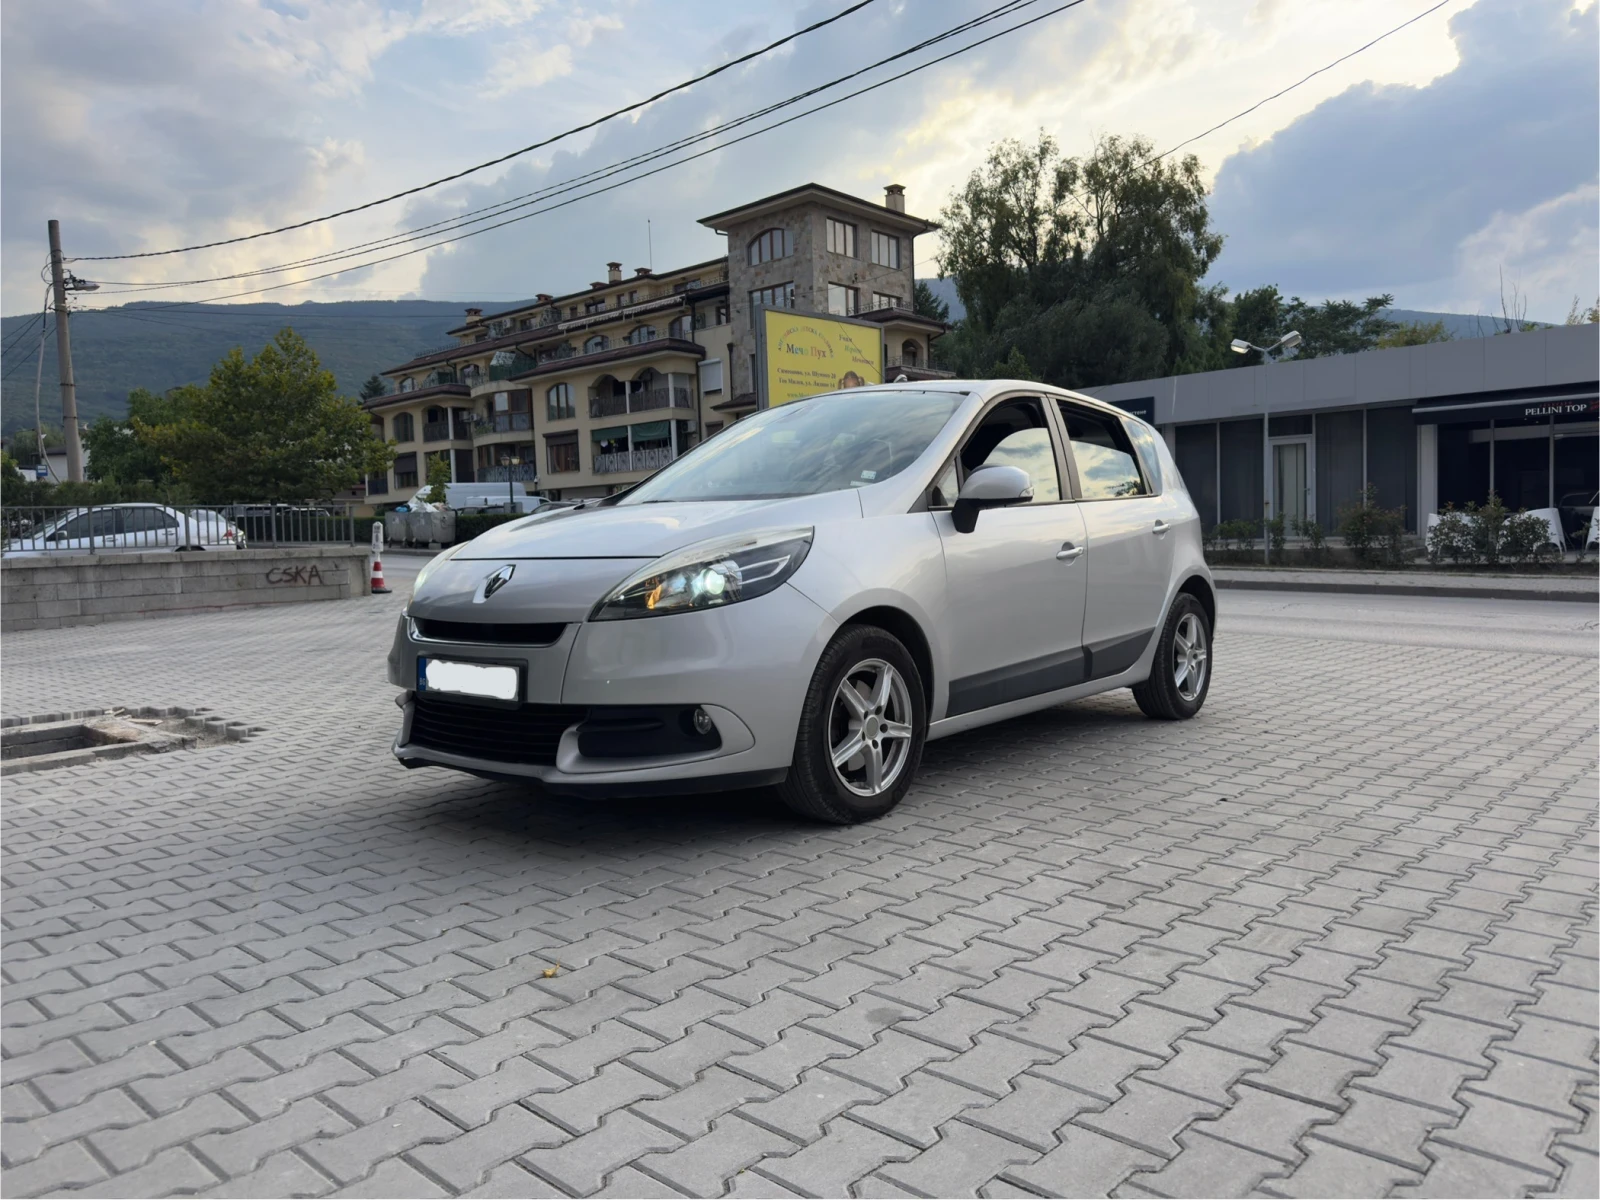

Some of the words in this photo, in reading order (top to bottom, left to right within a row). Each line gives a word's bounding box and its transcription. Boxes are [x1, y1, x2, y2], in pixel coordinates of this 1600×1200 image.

[786, 343, 809, 356] Мечо
[810, 346, 827, 360] Пух
[1525, 406, 1562, 415] PELLINI
[1565, 404, 1587, 412] TOP
[266, 564, 325, 585] CSKA
